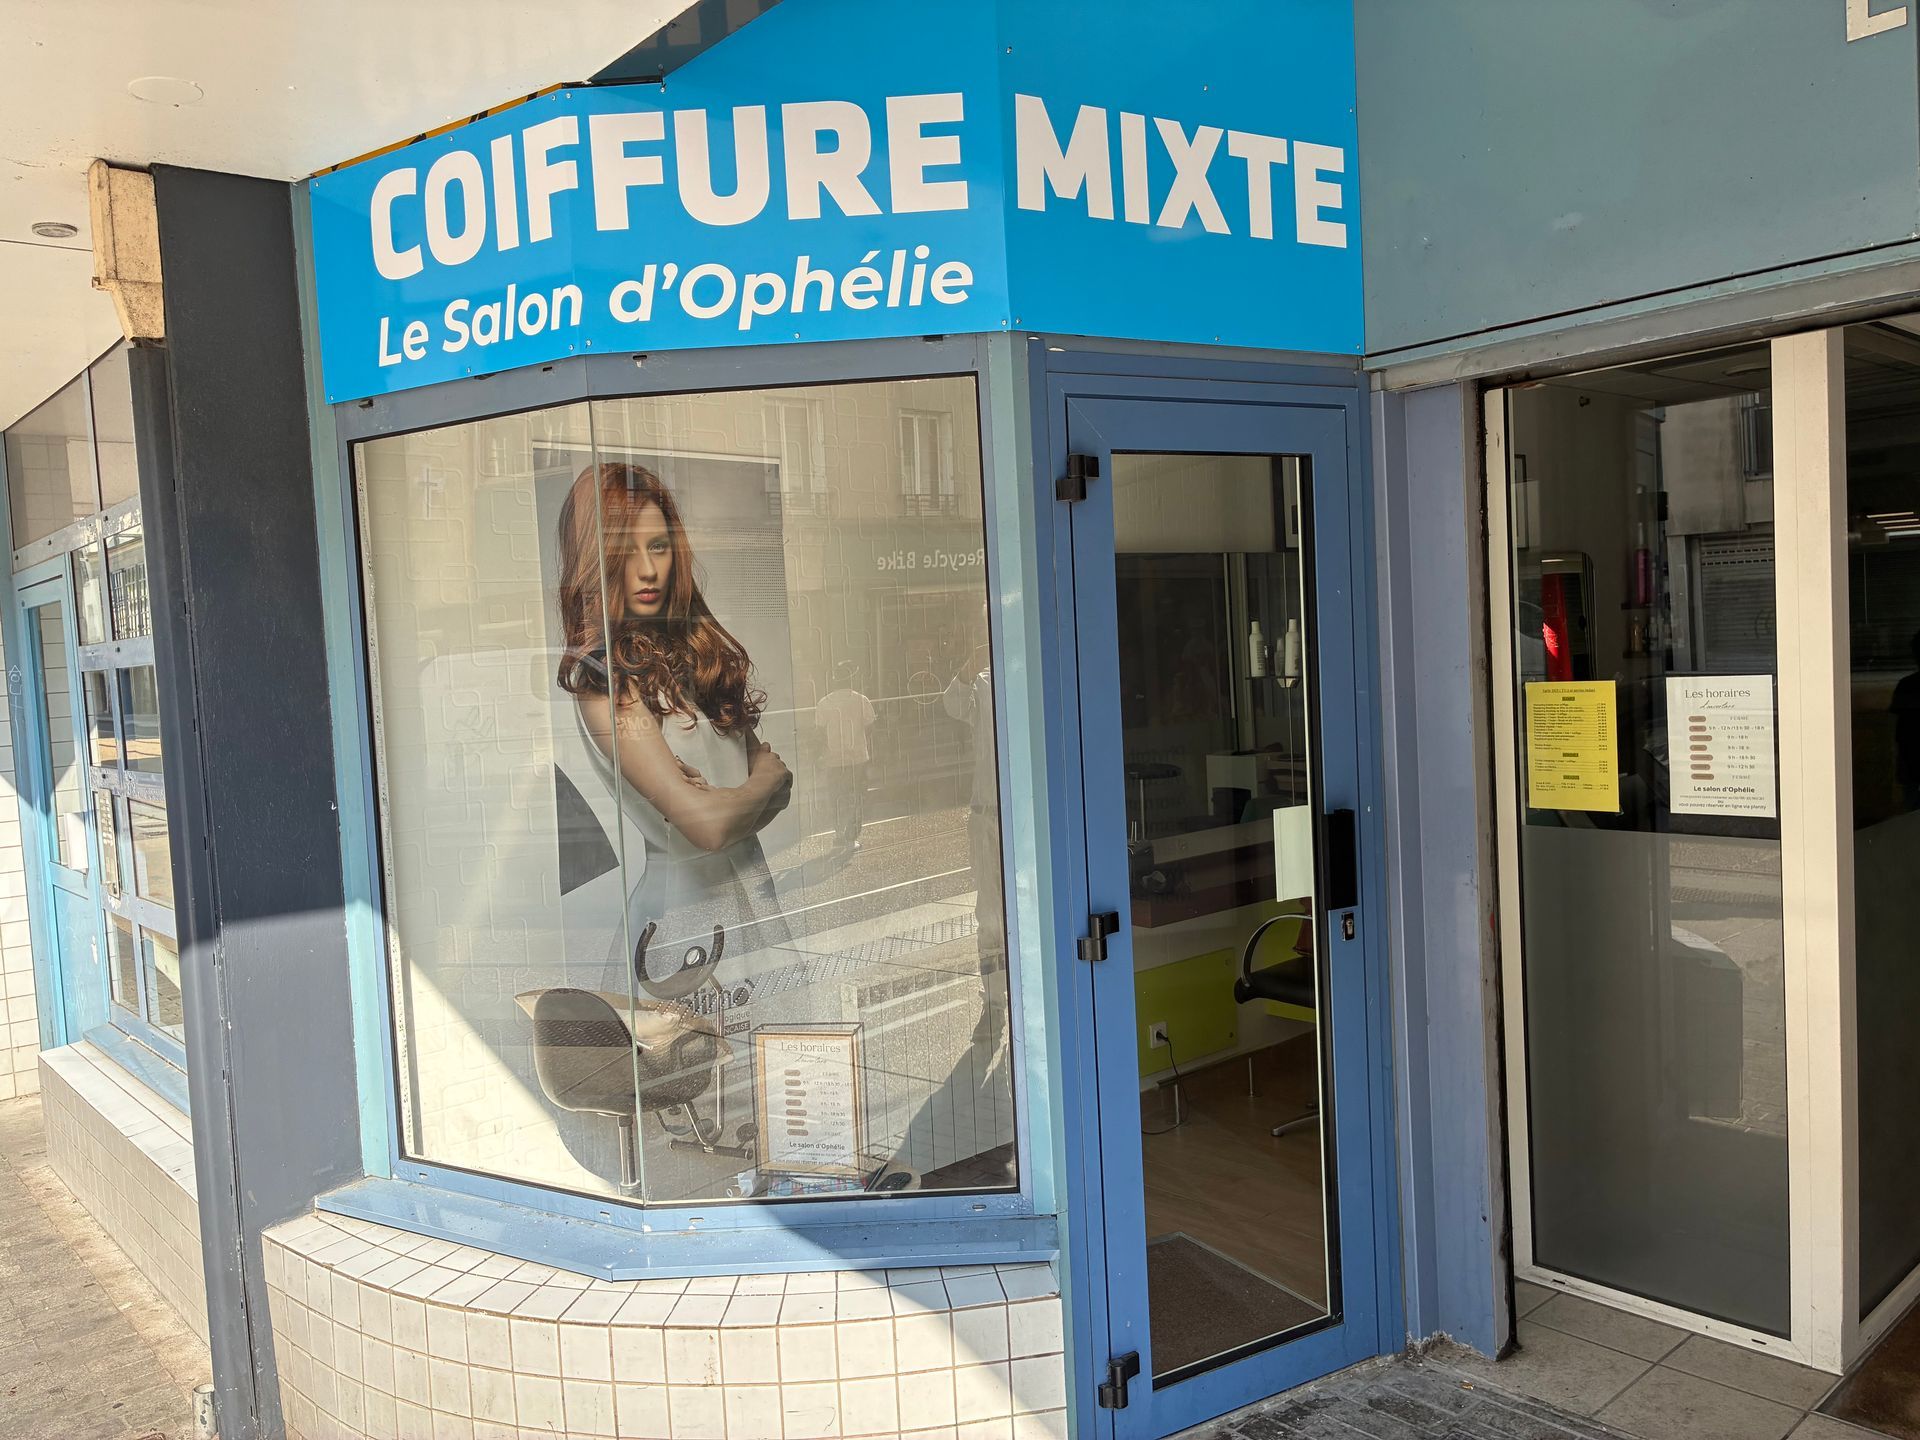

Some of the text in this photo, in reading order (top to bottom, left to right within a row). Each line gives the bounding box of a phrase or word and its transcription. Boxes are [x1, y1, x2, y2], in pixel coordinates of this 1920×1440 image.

[370, 92, 1347, 280] COIFFURE MIXTE
[378, 245, 974, 368] Le Salon d'Ophélie
[1685, 688, 1751, 699] Les horaires
[1722, 786, 1755, 794] d'Ophélie
[781, 1042, 841, 1053] Les horaires
